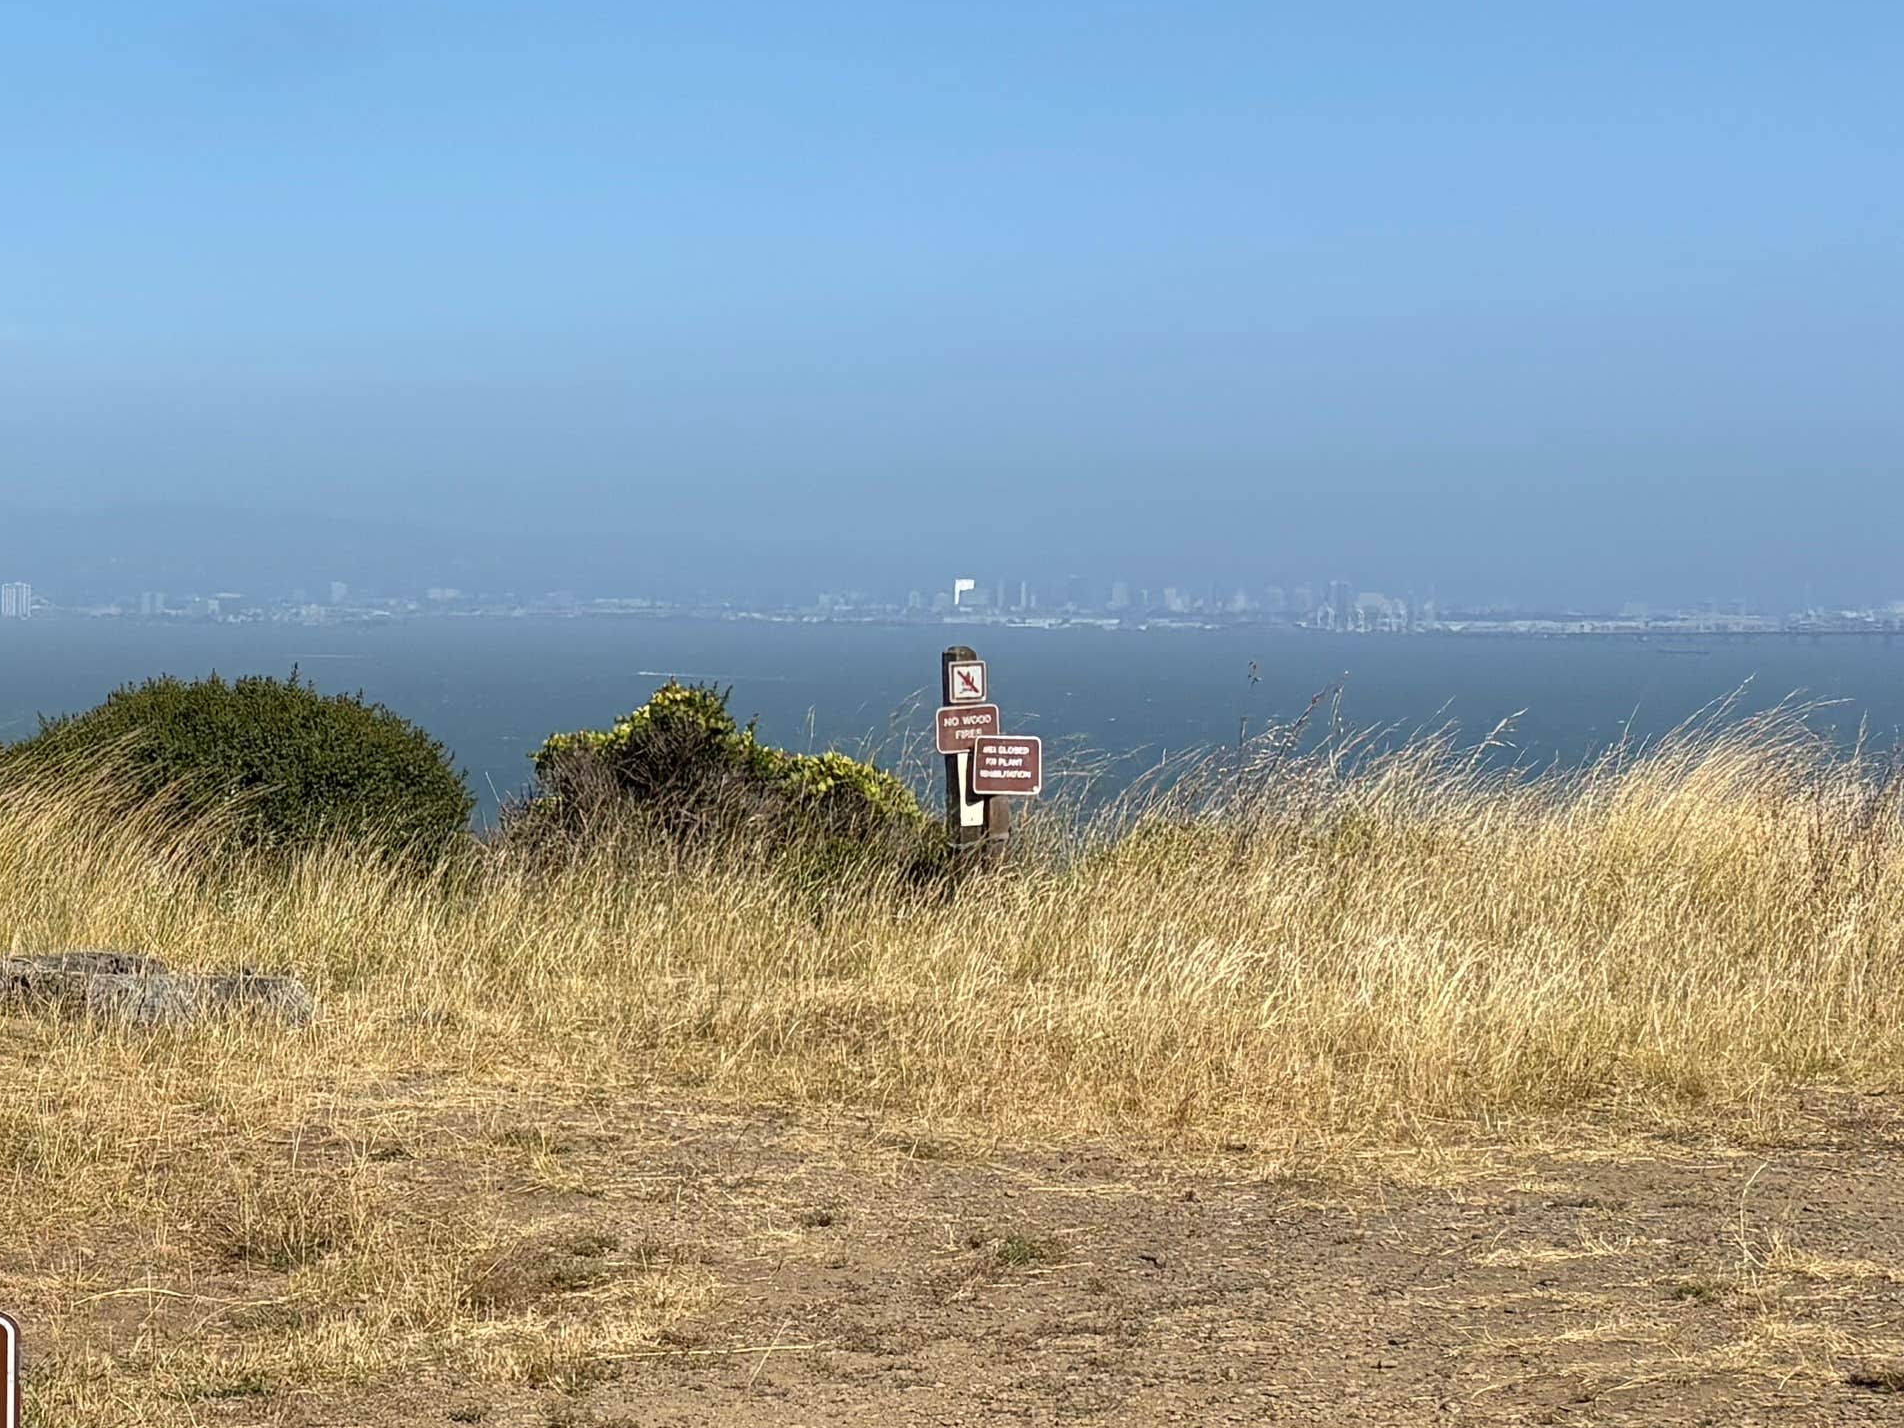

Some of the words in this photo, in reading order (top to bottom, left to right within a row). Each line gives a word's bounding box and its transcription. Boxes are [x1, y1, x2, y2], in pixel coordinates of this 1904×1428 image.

[944, 717, 959, 727] NO
[962, 714, 991, 725] WOOD
[998, 758, 1023, 766] PLANT
